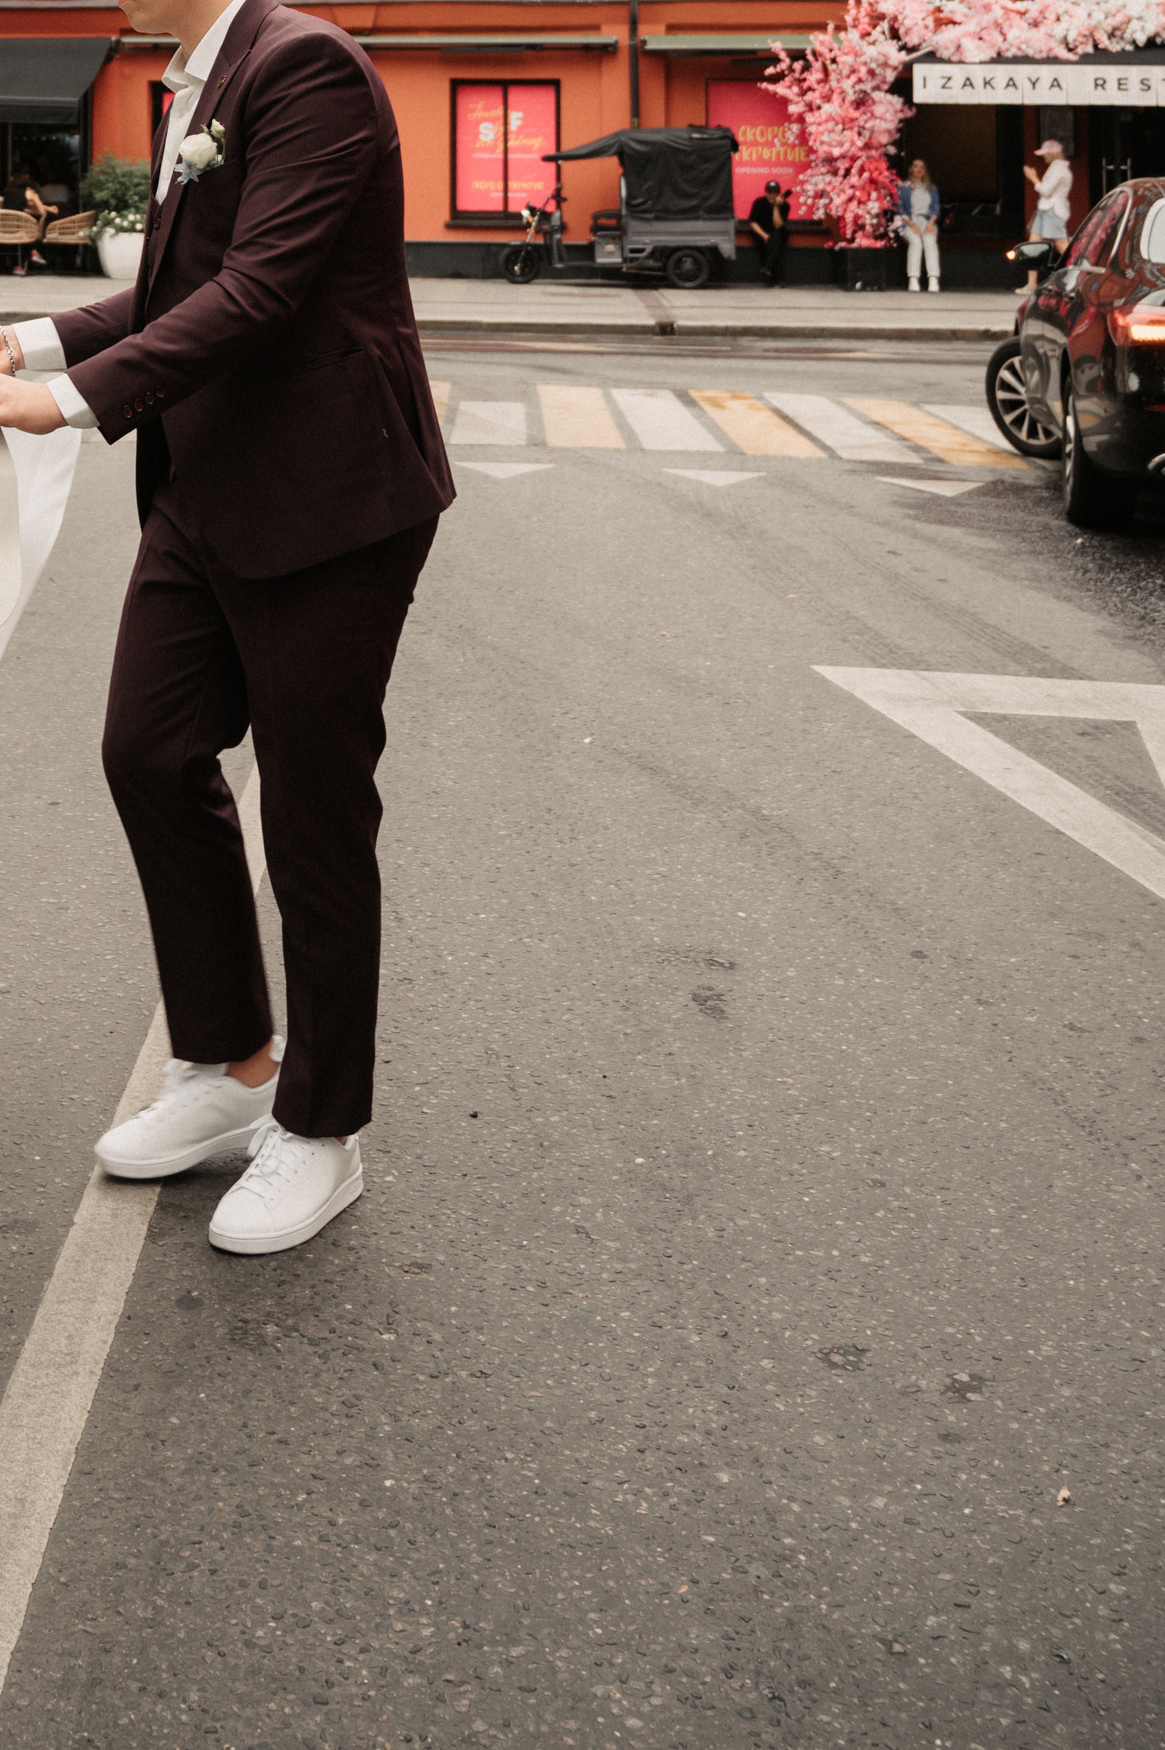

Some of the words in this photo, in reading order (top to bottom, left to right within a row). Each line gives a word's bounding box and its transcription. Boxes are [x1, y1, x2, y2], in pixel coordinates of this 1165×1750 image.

[922, 76, 1063, 91] IZAKAYA
[1094, 77, 1165, 92] RES
[735, 145, 810, 162] ТКРЫТИЕ
